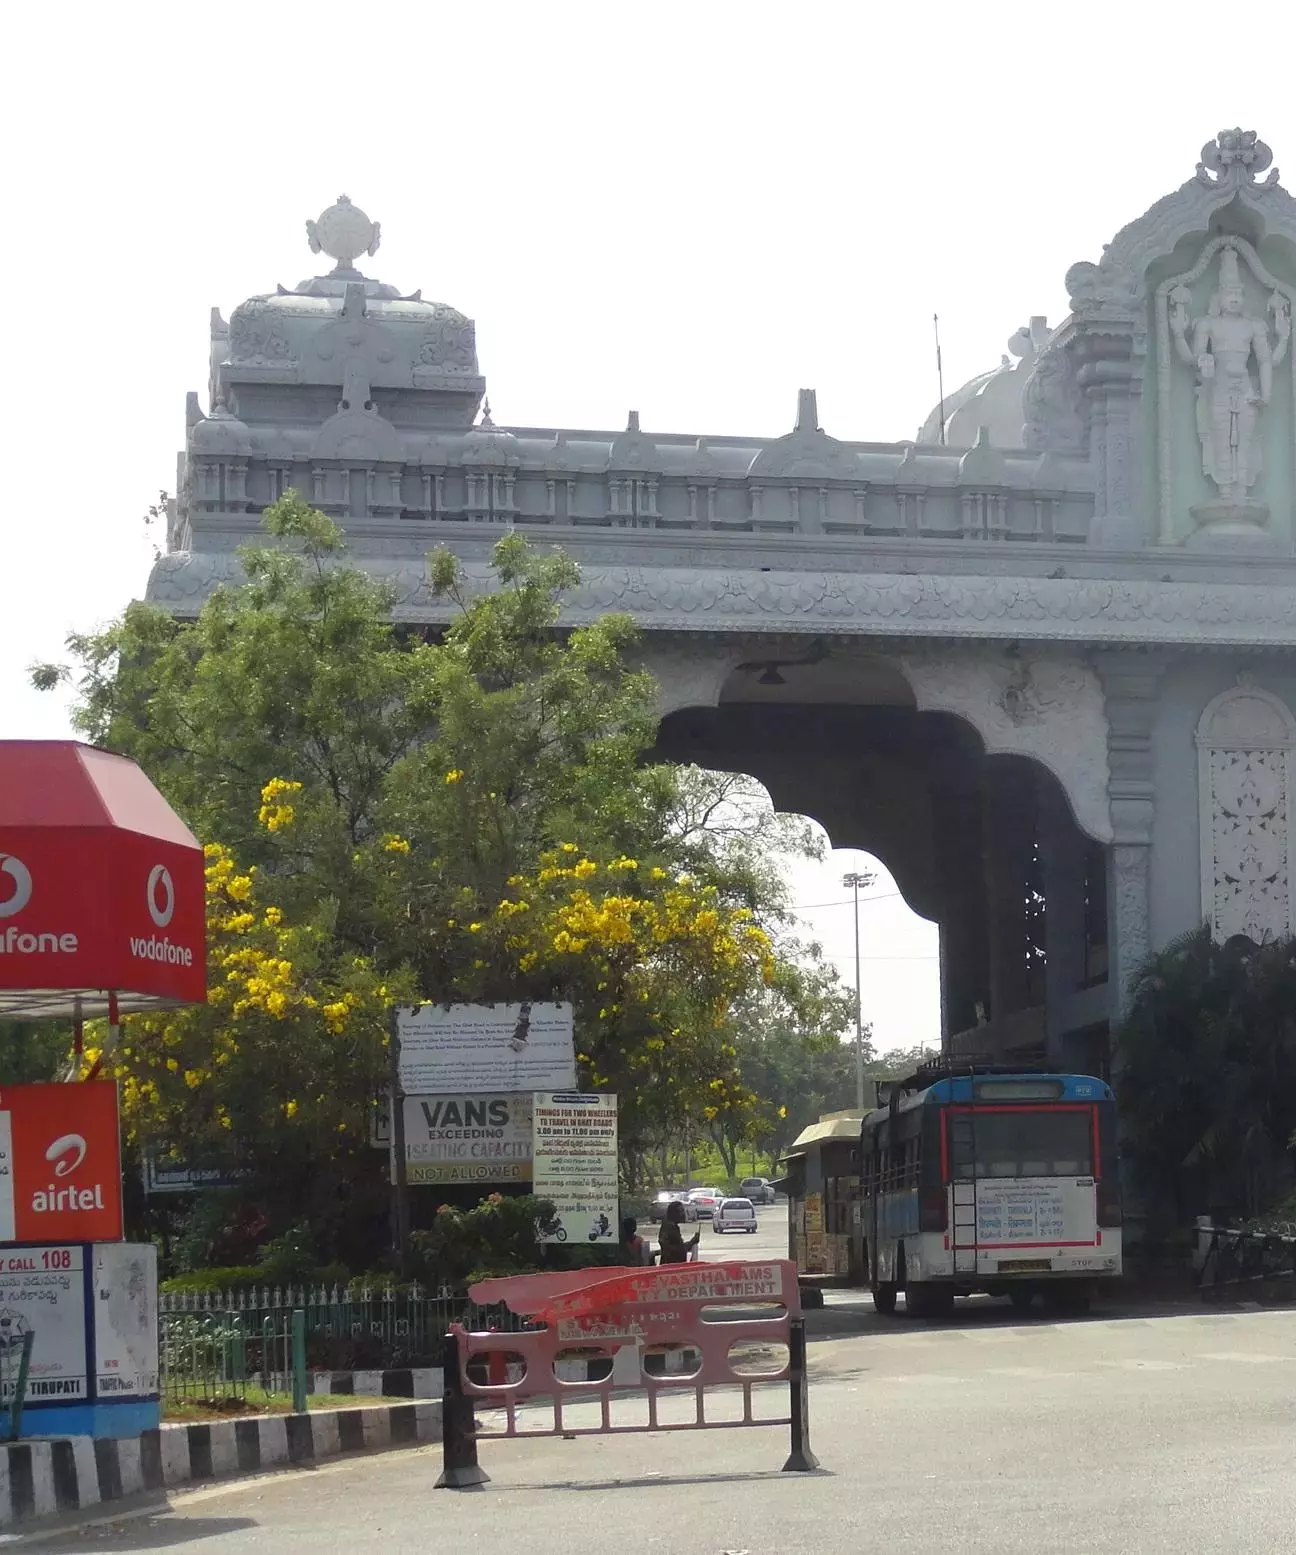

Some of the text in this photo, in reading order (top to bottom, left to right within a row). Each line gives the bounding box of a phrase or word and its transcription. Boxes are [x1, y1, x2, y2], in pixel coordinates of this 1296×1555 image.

[130, 935, 193, 968] vodafone
[420, 1099, 510, 1128] VANS
[428, 1129, 504, 1140] EXCEEDING
[414, 1165, 520, 1180] NOT ALLOWED
[32, 1184, 105, 1212] airtel
[8, 1258, 36, 1271] CALL
[42, 1250, 71, 1269] 108
[1071, 1259, 1093, 1267] STOP
[30, 1380, 80, 1396] TIRUPATI
